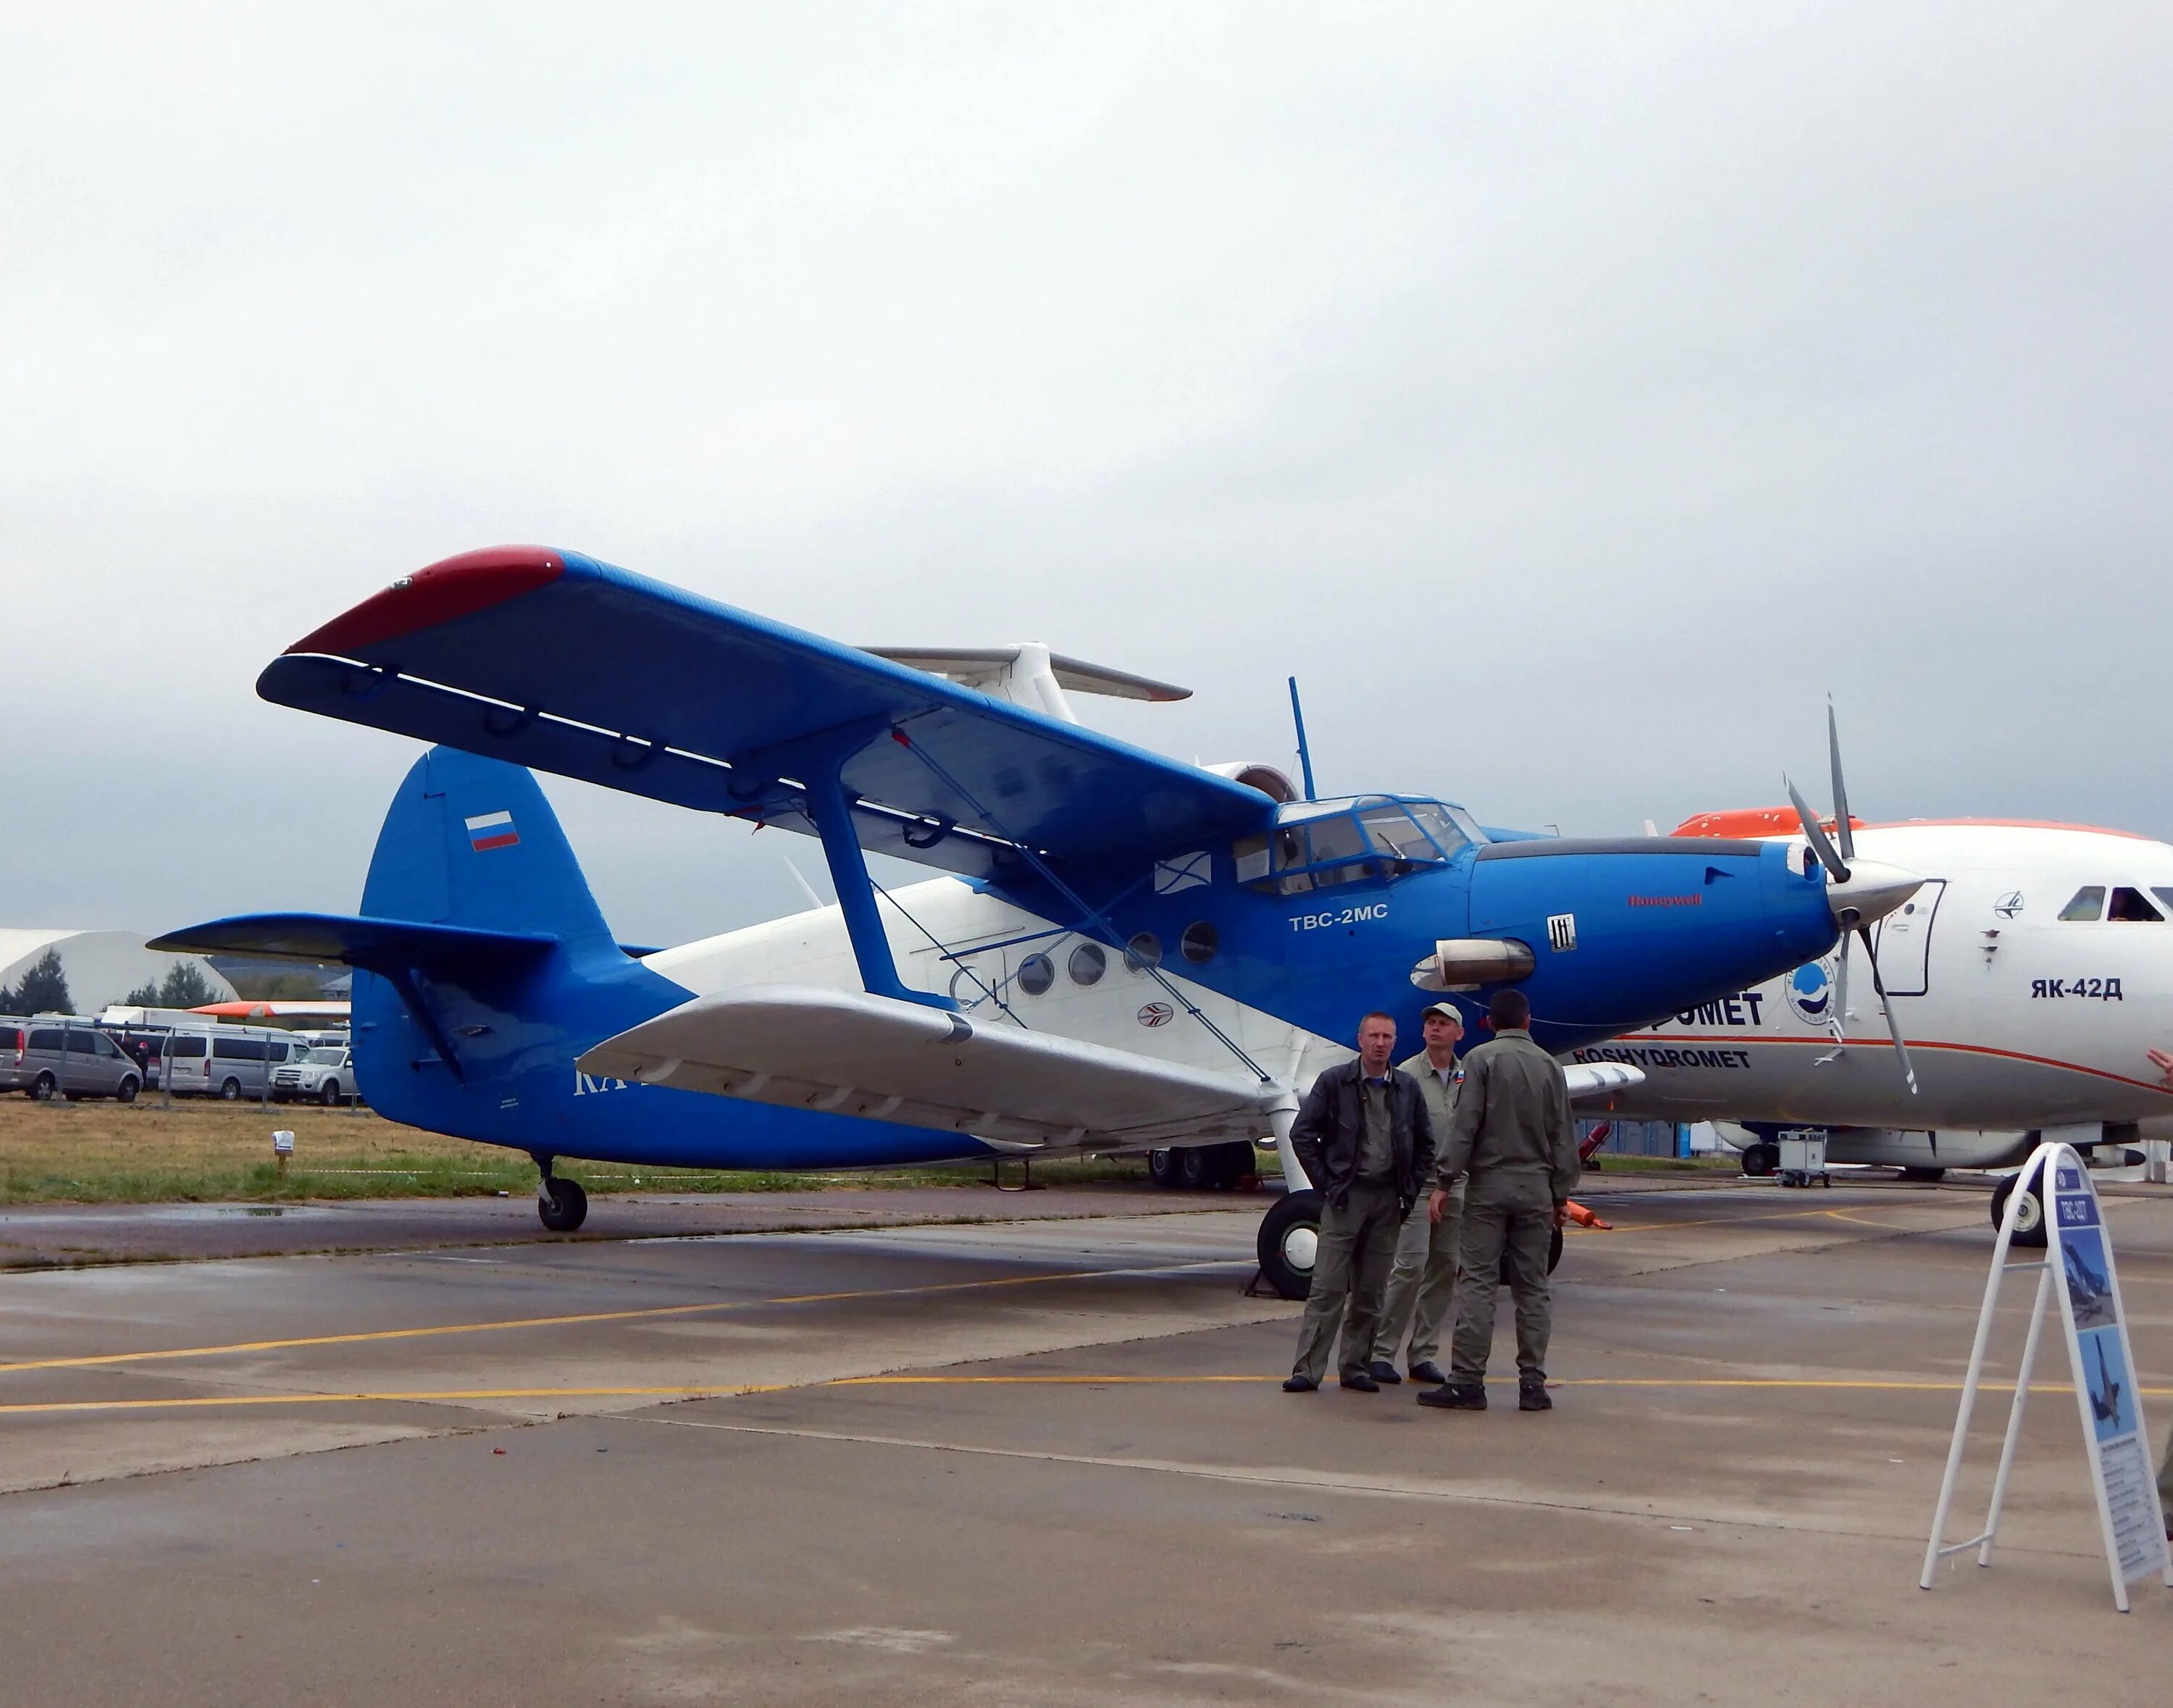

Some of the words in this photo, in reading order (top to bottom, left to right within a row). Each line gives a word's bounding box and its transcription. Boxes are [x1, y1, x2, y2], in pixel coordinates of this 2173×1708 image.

[1628, 893, 1701, 908] Honeywell
[1289, 903, 1388, 932] ТВС-2МС
[2031, 978, 2123, 1001] ЯК-42Д
